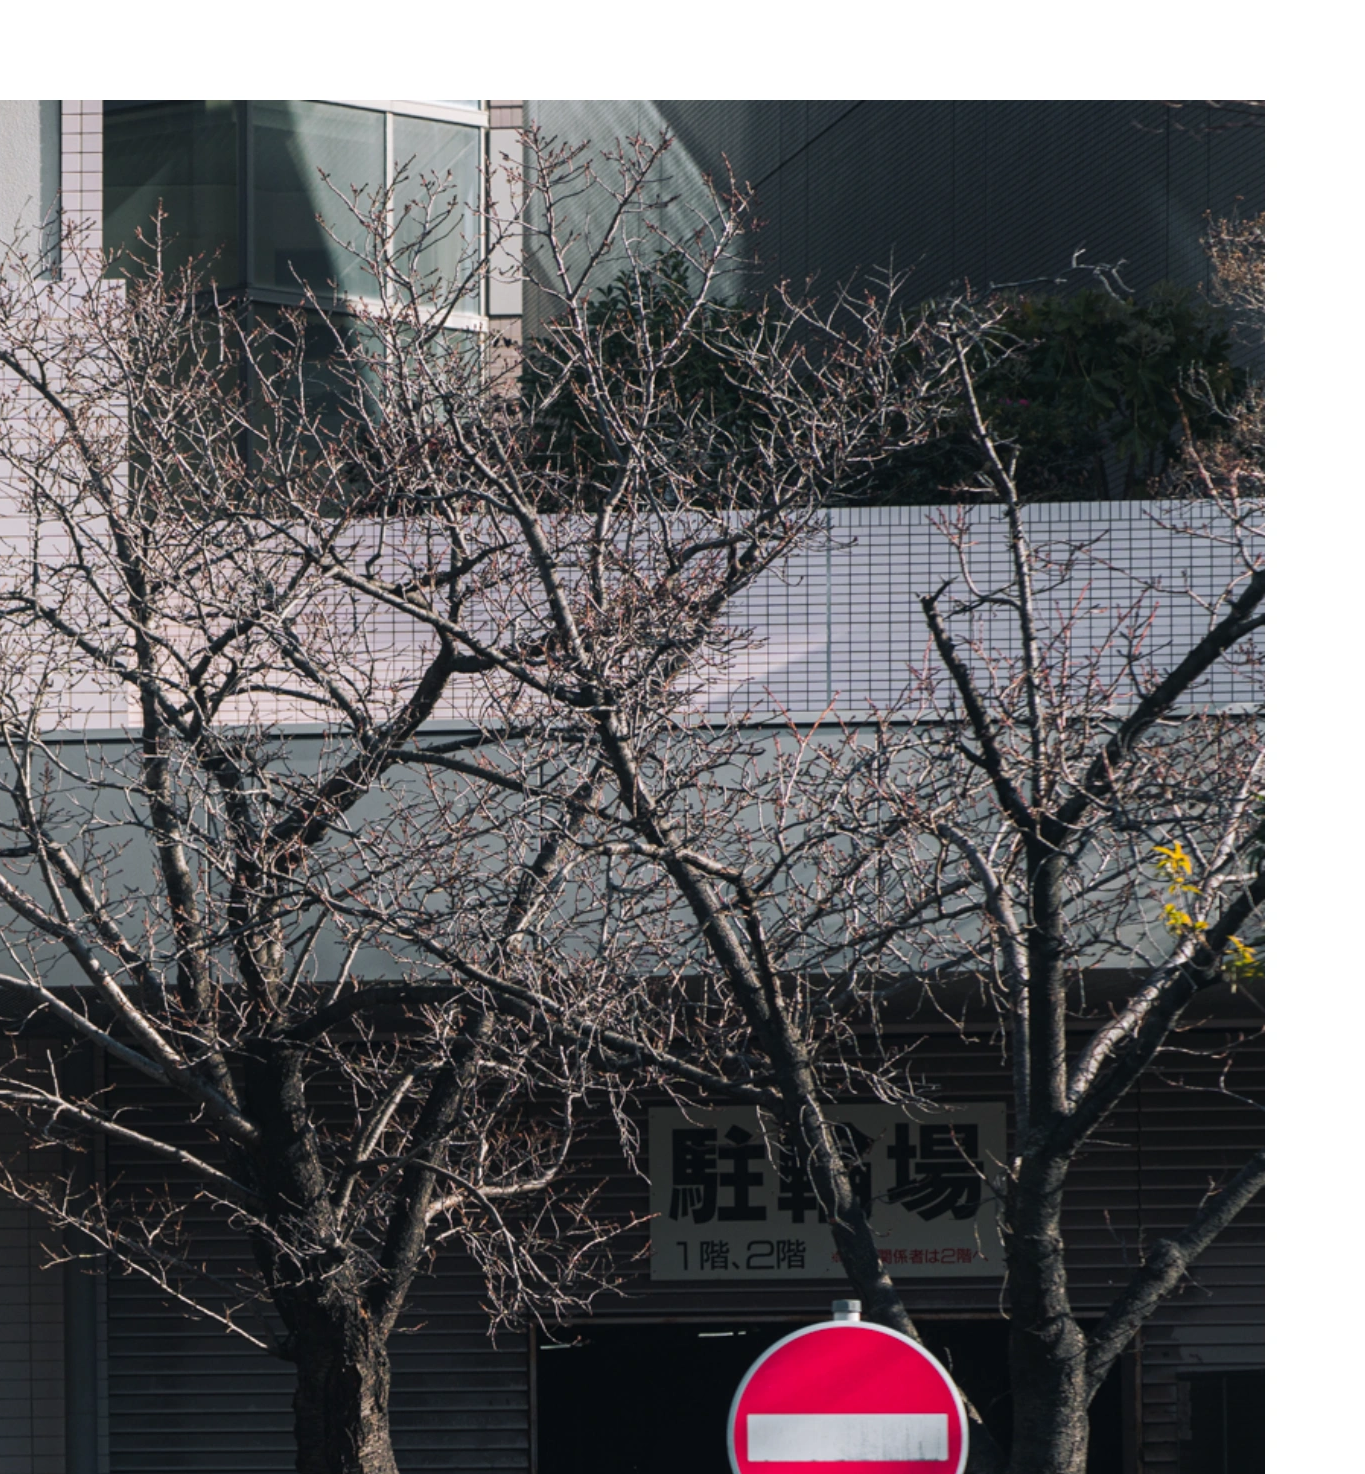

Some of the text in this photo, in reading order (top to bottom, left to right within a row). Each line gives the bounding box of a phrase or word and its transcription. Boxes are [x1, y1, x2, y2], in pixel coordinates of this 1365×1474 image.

[668, 1122, 985, 1225] 駐輪場
[676, 1239, 807, 1271] 1階、2階
